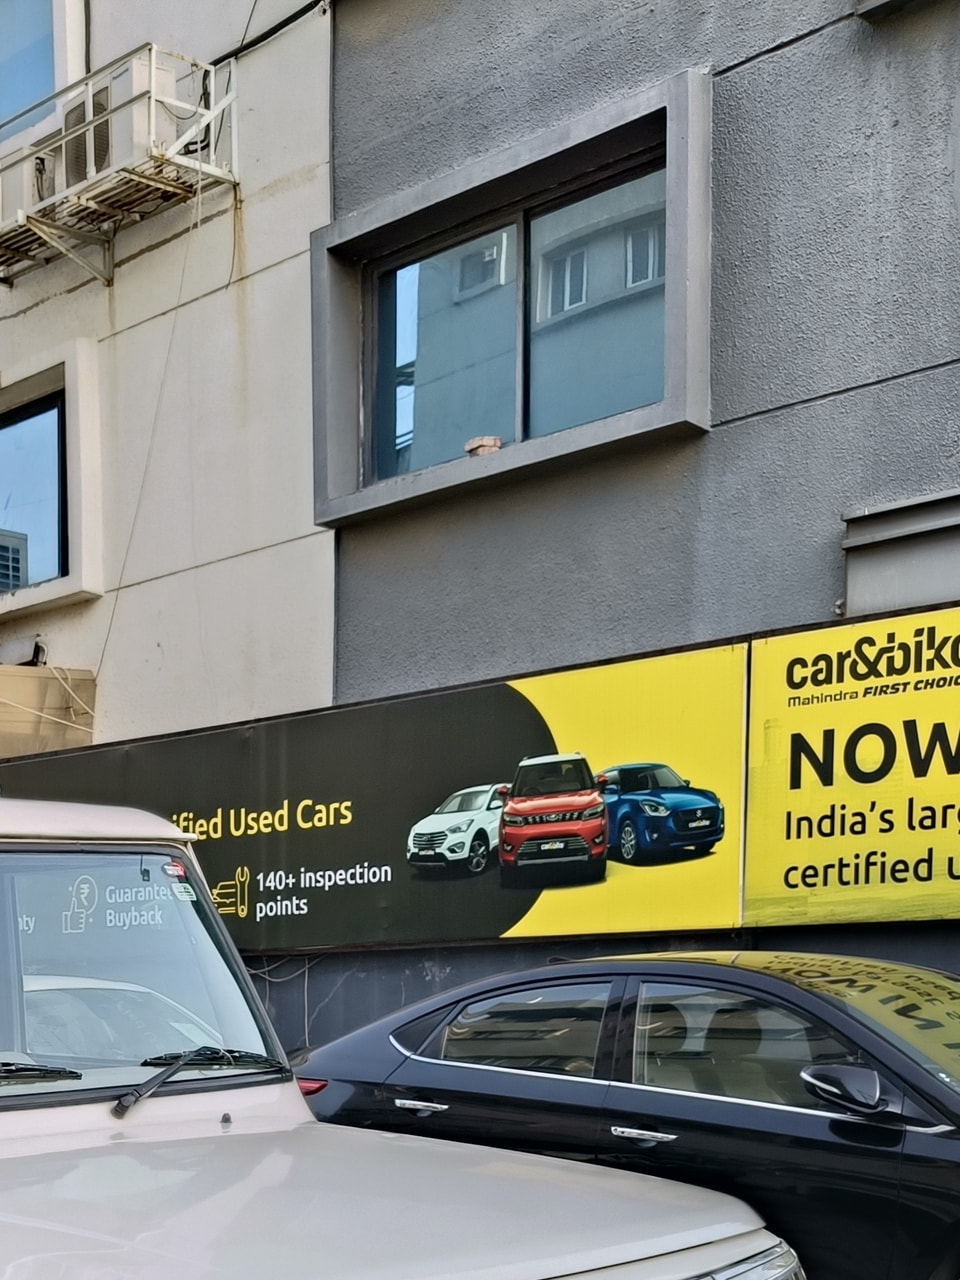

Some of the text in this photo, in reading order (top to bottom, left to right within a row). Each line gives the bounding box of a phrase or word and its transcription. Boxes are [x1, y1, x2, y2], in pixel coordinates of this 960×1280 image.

[787, 690, 859, 708] Mahindra
[862, 681, 911, 698] FIRST
[789, 718, 960, 790] NOW
[229, 799, 289, 837] Used
[296, 799, 353, 829] Cars
[785, 797, 960, 840] India's lar
[256, 861, 392, 892] 140+ inspection
[783, 847, 933, 889] certified
[106, 904, 163, 930] Buyback
[255, 896, 309, 922] points
